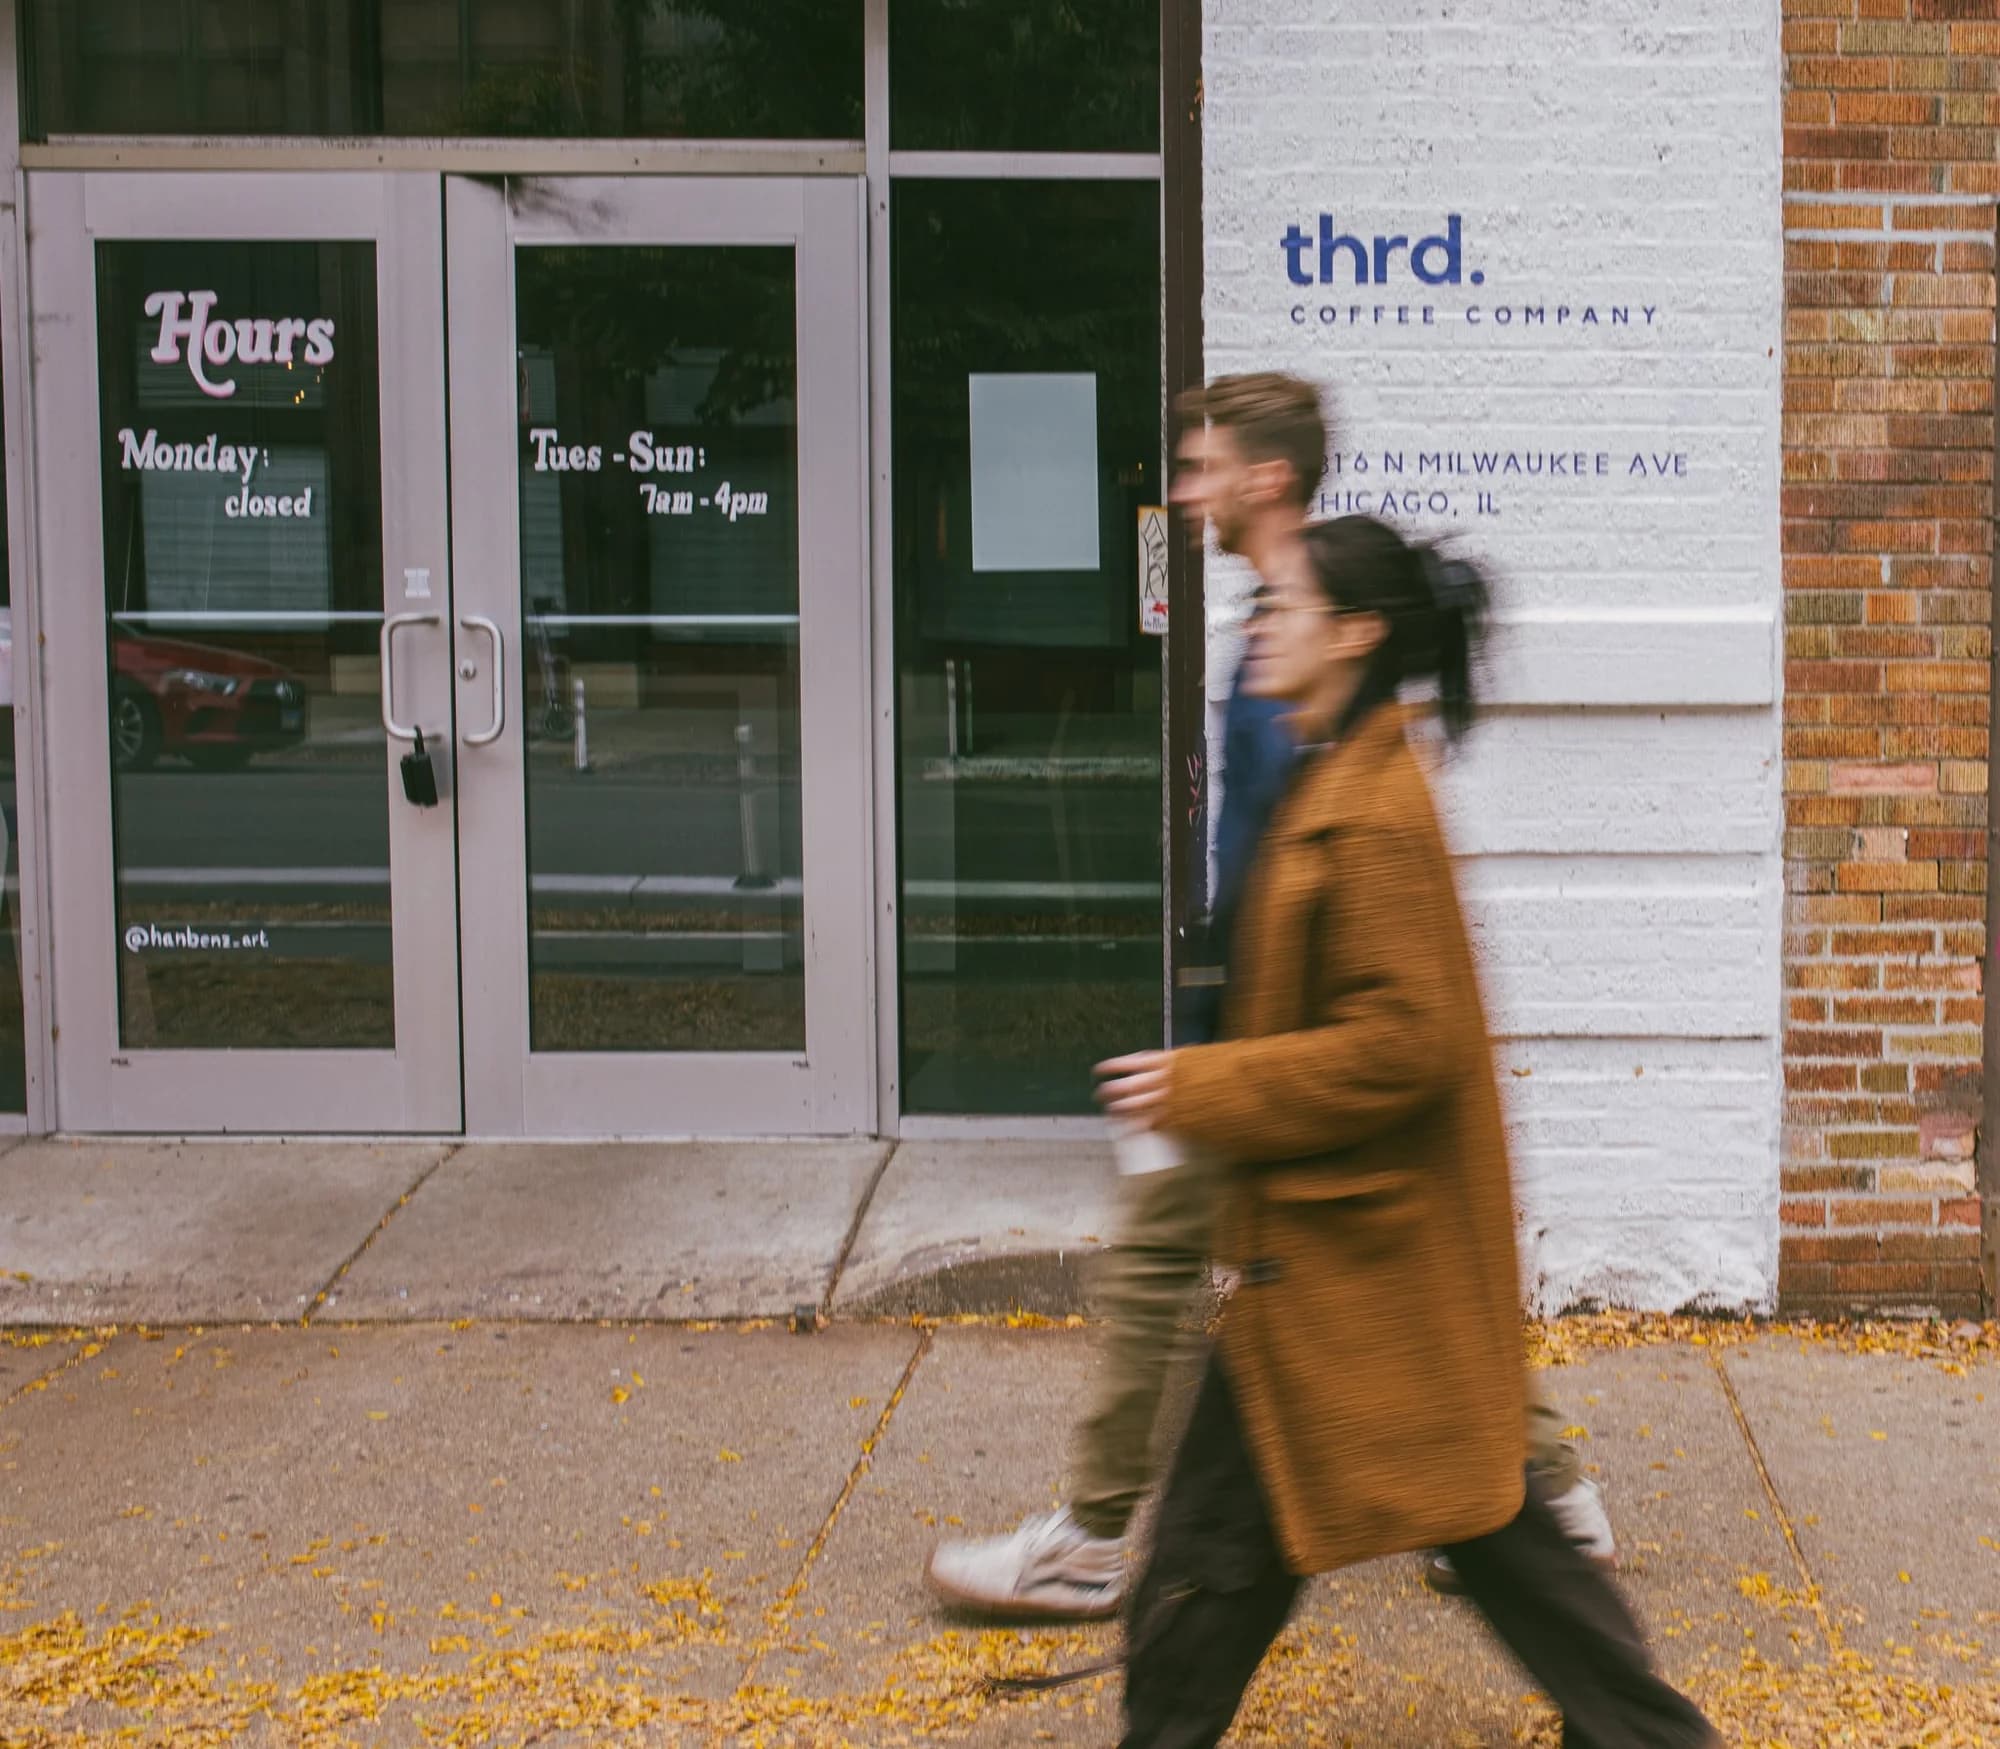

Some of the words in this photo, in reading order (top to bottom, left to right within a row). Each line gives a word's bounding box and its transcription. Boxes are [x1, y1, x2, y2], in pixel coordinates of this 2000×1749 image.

[1280, 212, 1485, 286] thrd.
[1290, 304, 1435, 325] COFFEE
[1466, 304, 1658, 325] COMPANY
[144, 290, 335, 397] Hours
[118, 428, 270, 483] Monday:
[530, 428, 601, 472] Tues
[1384, 451, 1403, 474] N
[1419, 451, 1609, 475] MILWAUKEE
[1629, 453, 1687, 477] AVE
[225, 487, 312, 517] closed
[1306, 490, 1458, 517] HICAGO,
[1477, 491, 1500, 515] IL
